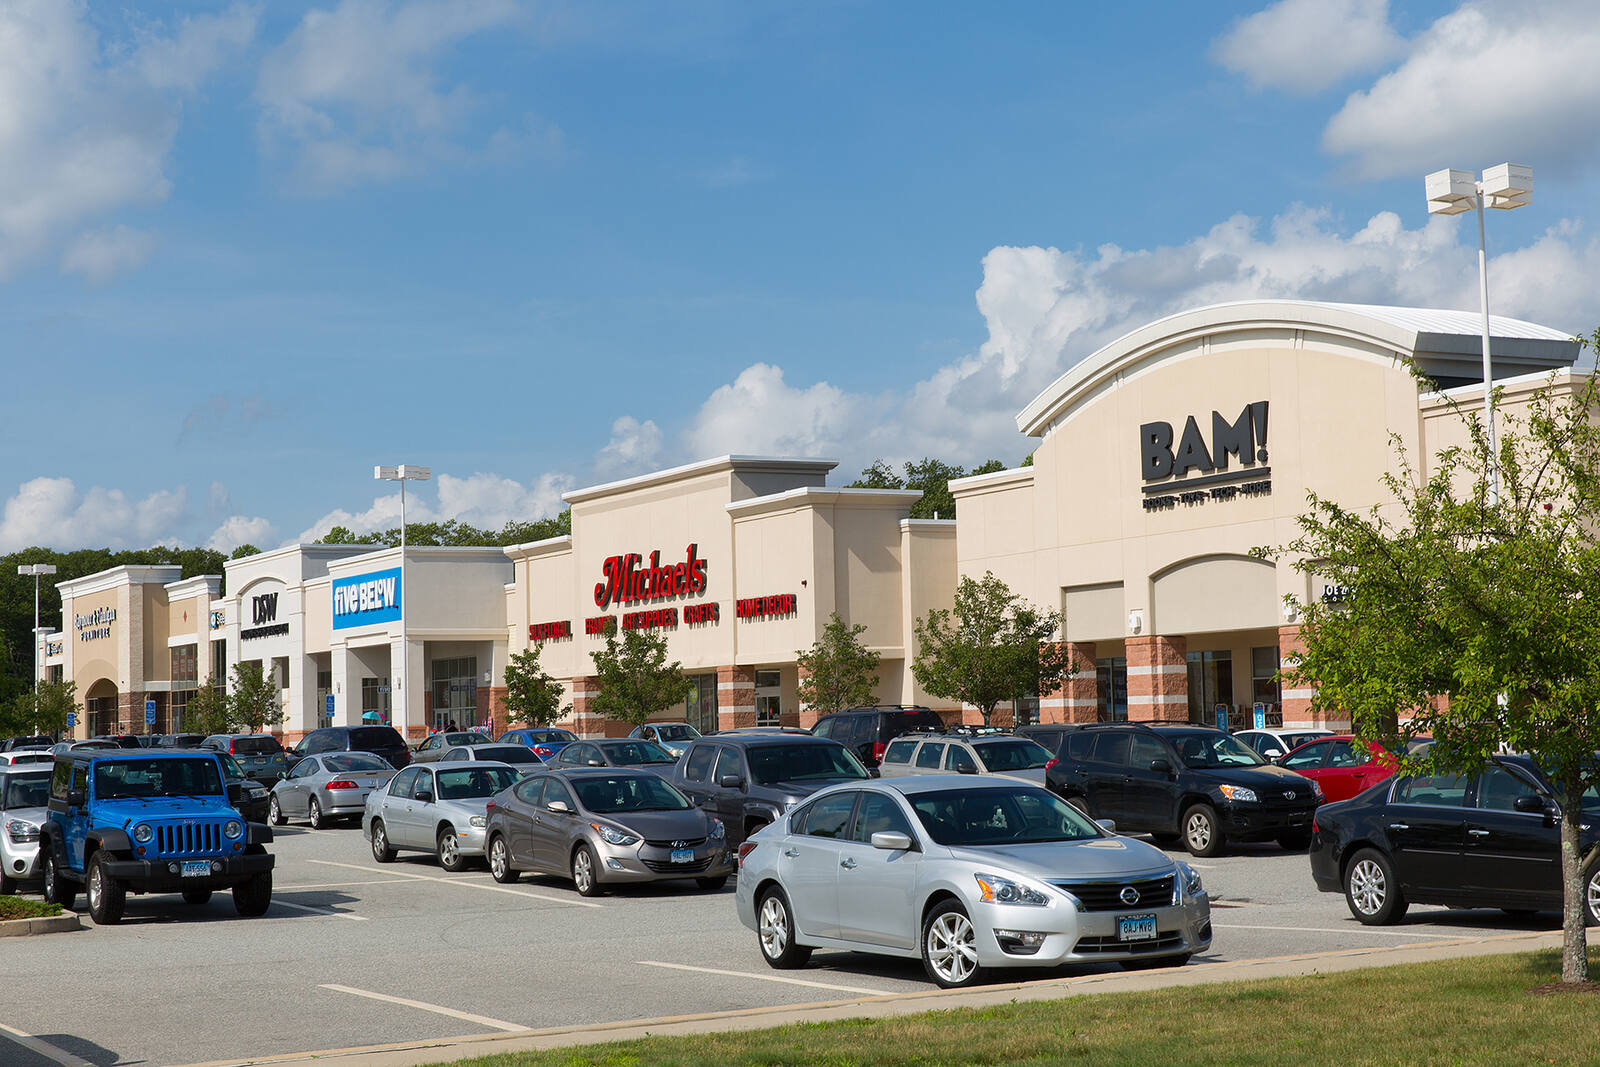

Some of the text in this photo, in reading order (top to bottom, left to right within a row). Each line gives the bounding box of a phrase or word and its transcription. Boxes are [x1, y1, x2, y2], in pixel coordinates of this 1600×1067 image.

[1140, 401, 1269, 481] BAM!
[1209, 486, 1236, 499] TECH
[594, 543, 707, 606] Michaels
[1322, 585, 1339, 595] JOE
[252, 592, 278, 625] DSW
[334, 584, 358, 615] five
[736, 594, 795, 618] HOME DECOR
[529, 624, 543, 640] SILK
[543, 621, 571, 639] FLORAL
[622, 612, 637, 630] ART
[638, 608, 677, 629] SUPPLIES
[683, 603, 718, 624] CRAFTS
